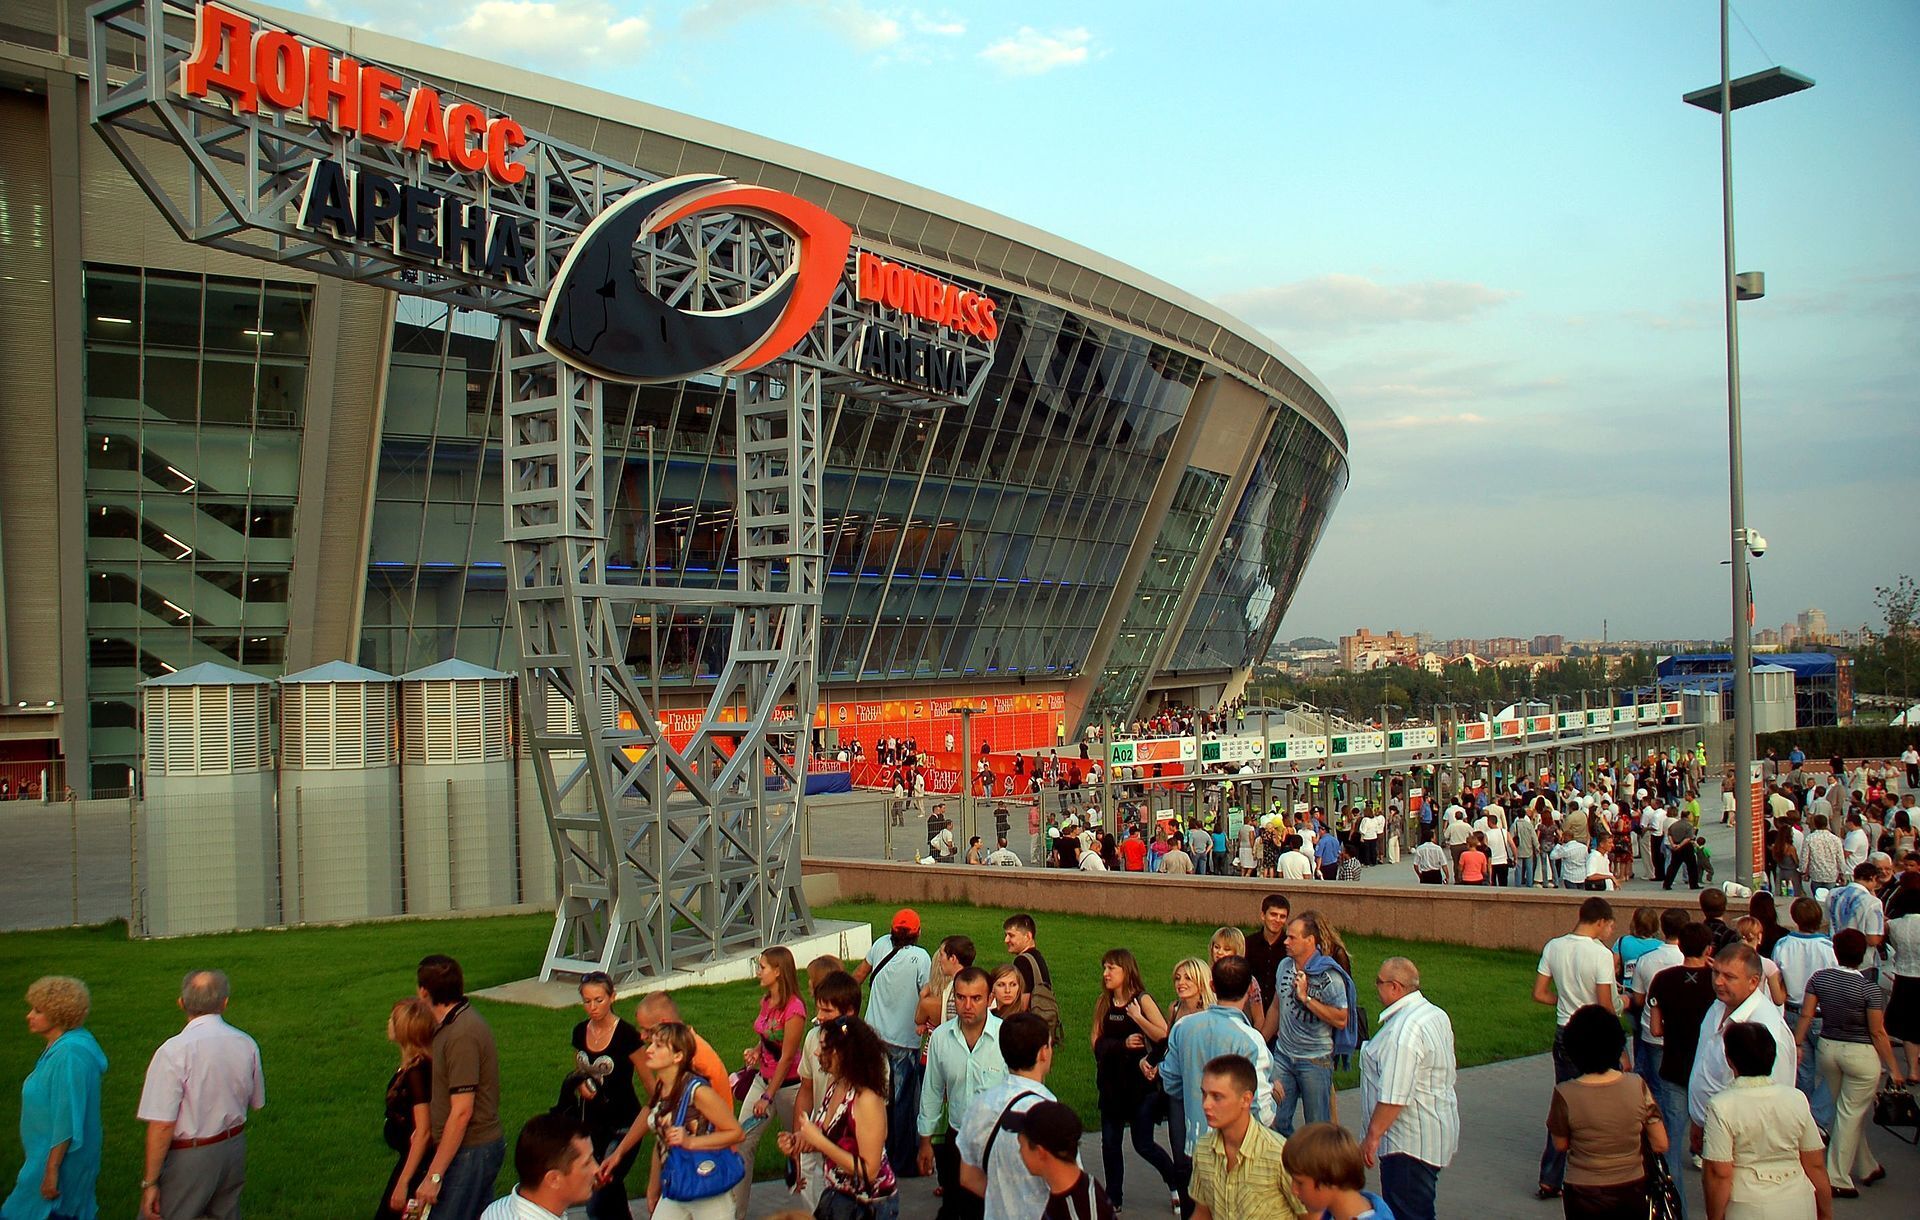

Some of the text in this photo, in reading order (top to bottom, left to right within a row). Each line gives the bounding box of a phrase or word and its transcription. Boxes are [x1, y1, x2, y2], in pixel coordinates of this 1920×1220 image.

[180, 4, 526, 187] ДОНБАСС
[297, 157, 526, 284] АРЕНА
[856, 250, 998, 342] DONBASS
[856, 324, 969, 398] ARENA
[856, 704, 882, 715] ГРАНД
[860, 712, 877, 722] ШОУ
[668, 713, 703, 725] ГРАНД
[674, 722, 697, 732] ШОУ
[1112, 747, 1133, 762] A02
